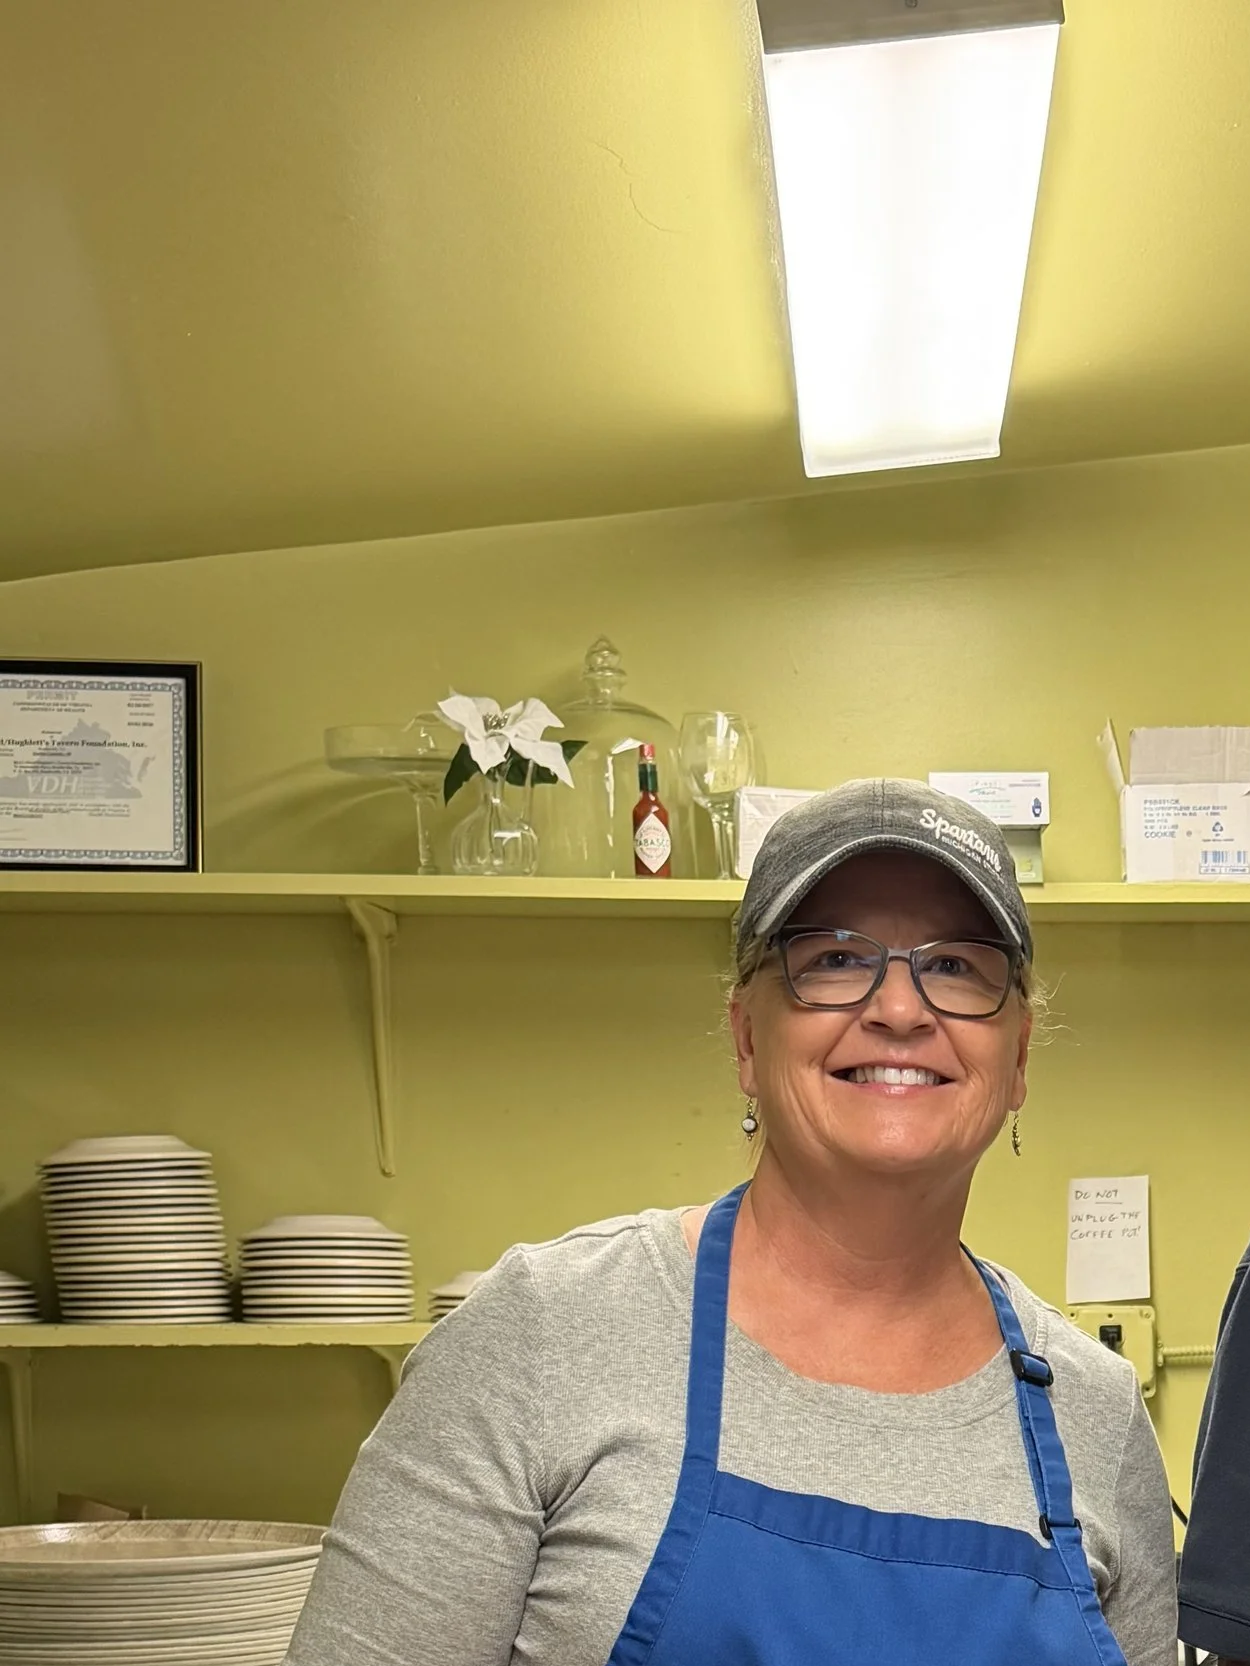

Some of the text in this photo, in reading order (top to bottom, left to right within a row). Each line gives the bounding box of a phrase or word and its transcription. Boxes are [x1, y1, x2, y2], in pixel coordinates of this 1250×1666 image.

[51, 739, 80, 747] Tavern
[81, 739, 130, 748] Foundation,
[27, 775, 78, 794] VDH
[920, 808, 1001, 872] Spartans
[1074, 1188, 1119, 1200] DO NOT
[1071, 1214, 1118, 1223] UNPLUG
[1070, 1229, 1114, 1241] COFFEE
